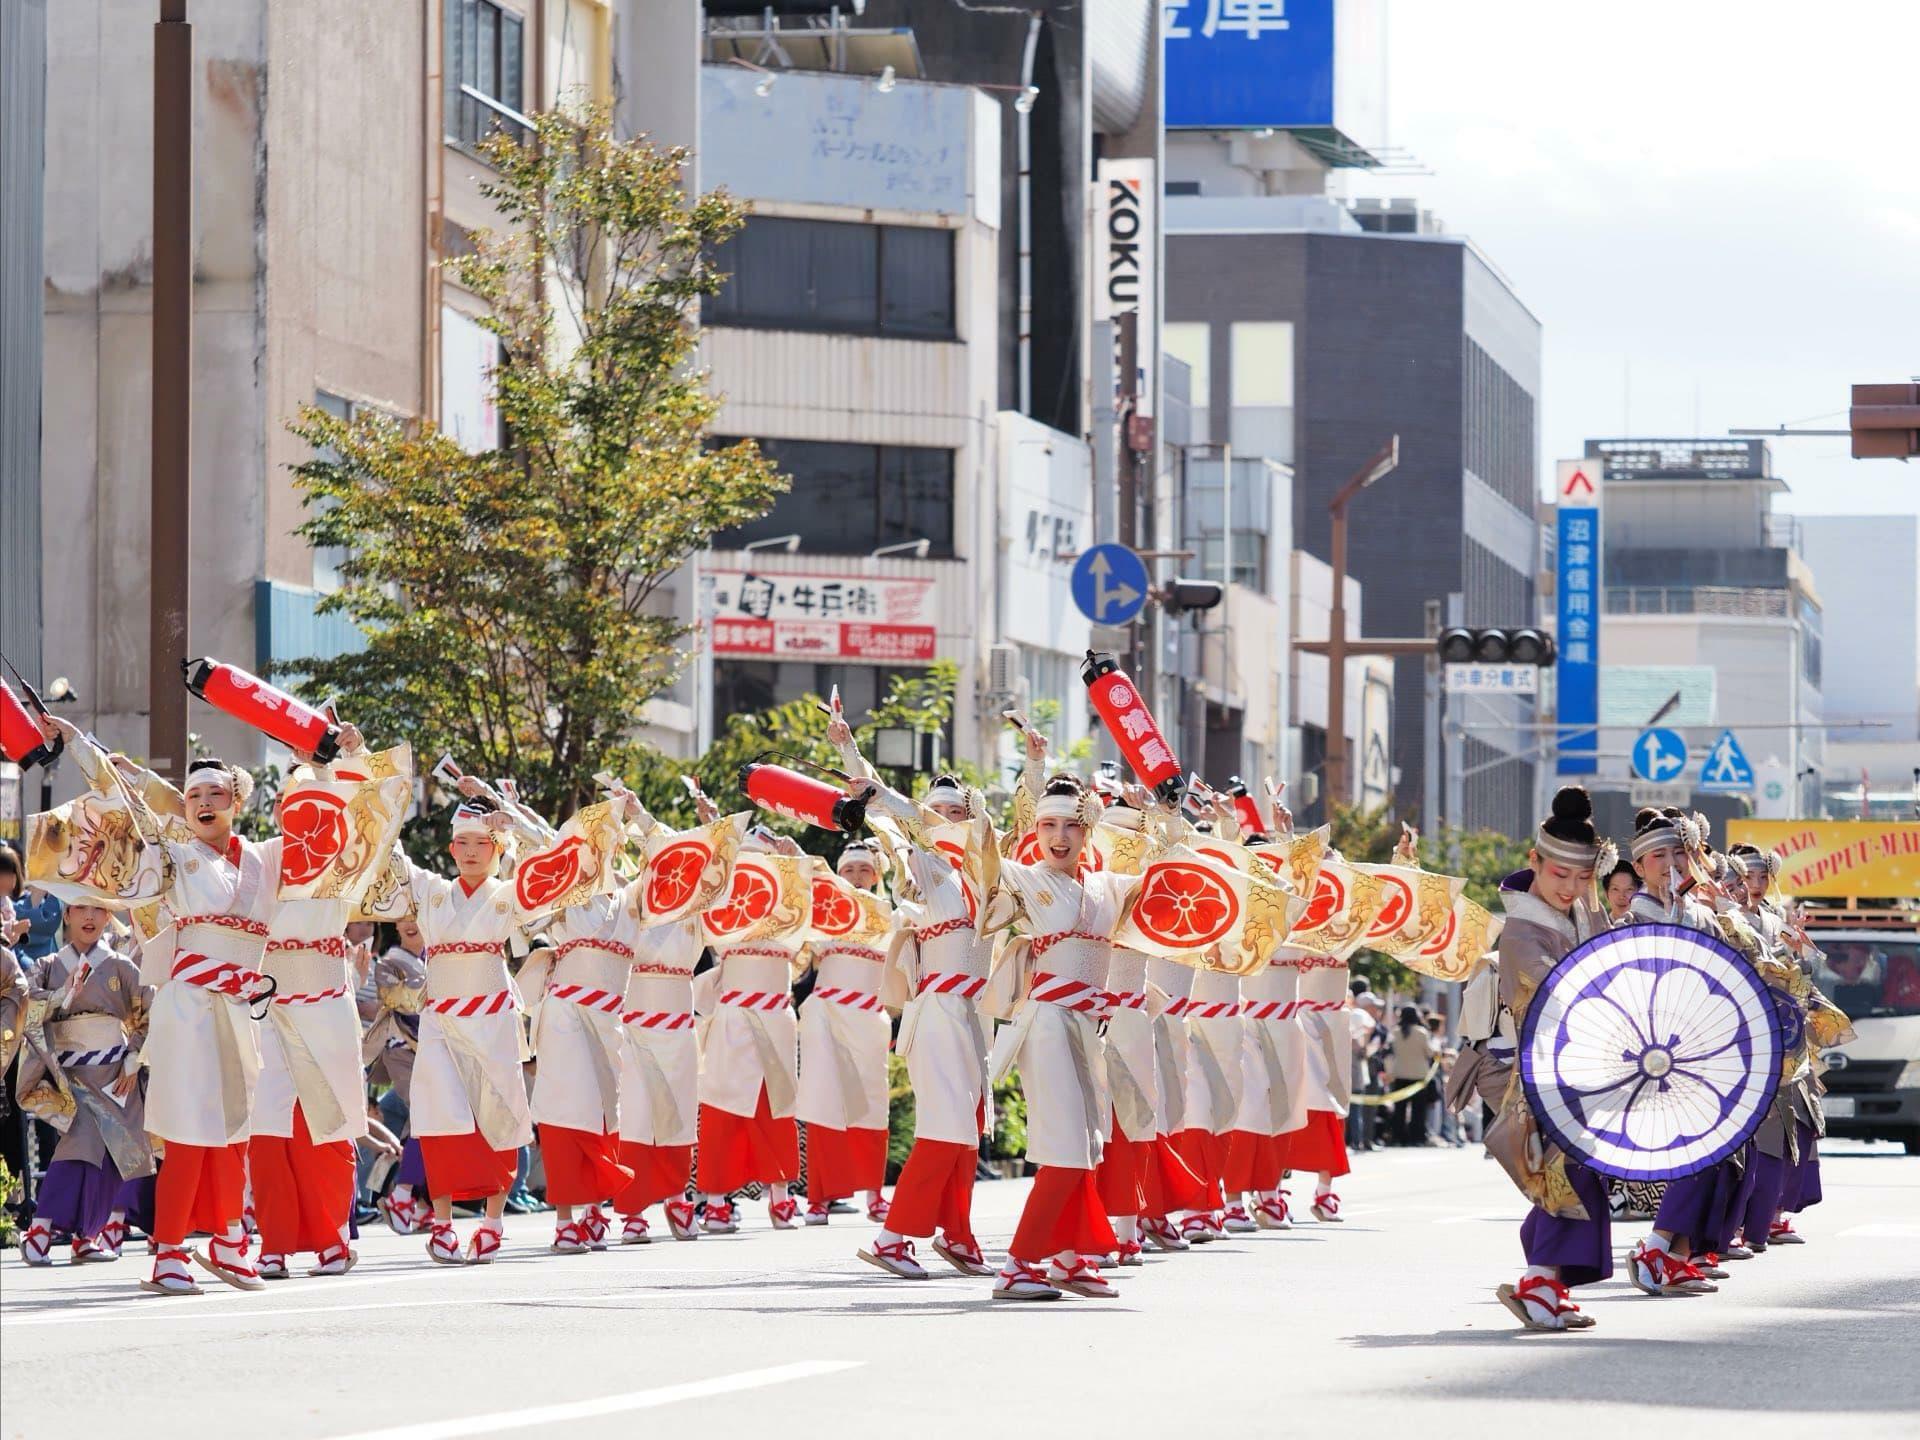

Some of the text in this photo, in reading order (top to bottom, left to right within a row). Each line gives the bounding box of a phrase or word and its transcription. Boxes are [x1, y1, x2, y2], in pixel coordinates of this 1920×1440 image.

[1109, 179, 1141, 321] KOKU
[1567, 519, 1590, 663] 沼津信用金庫
